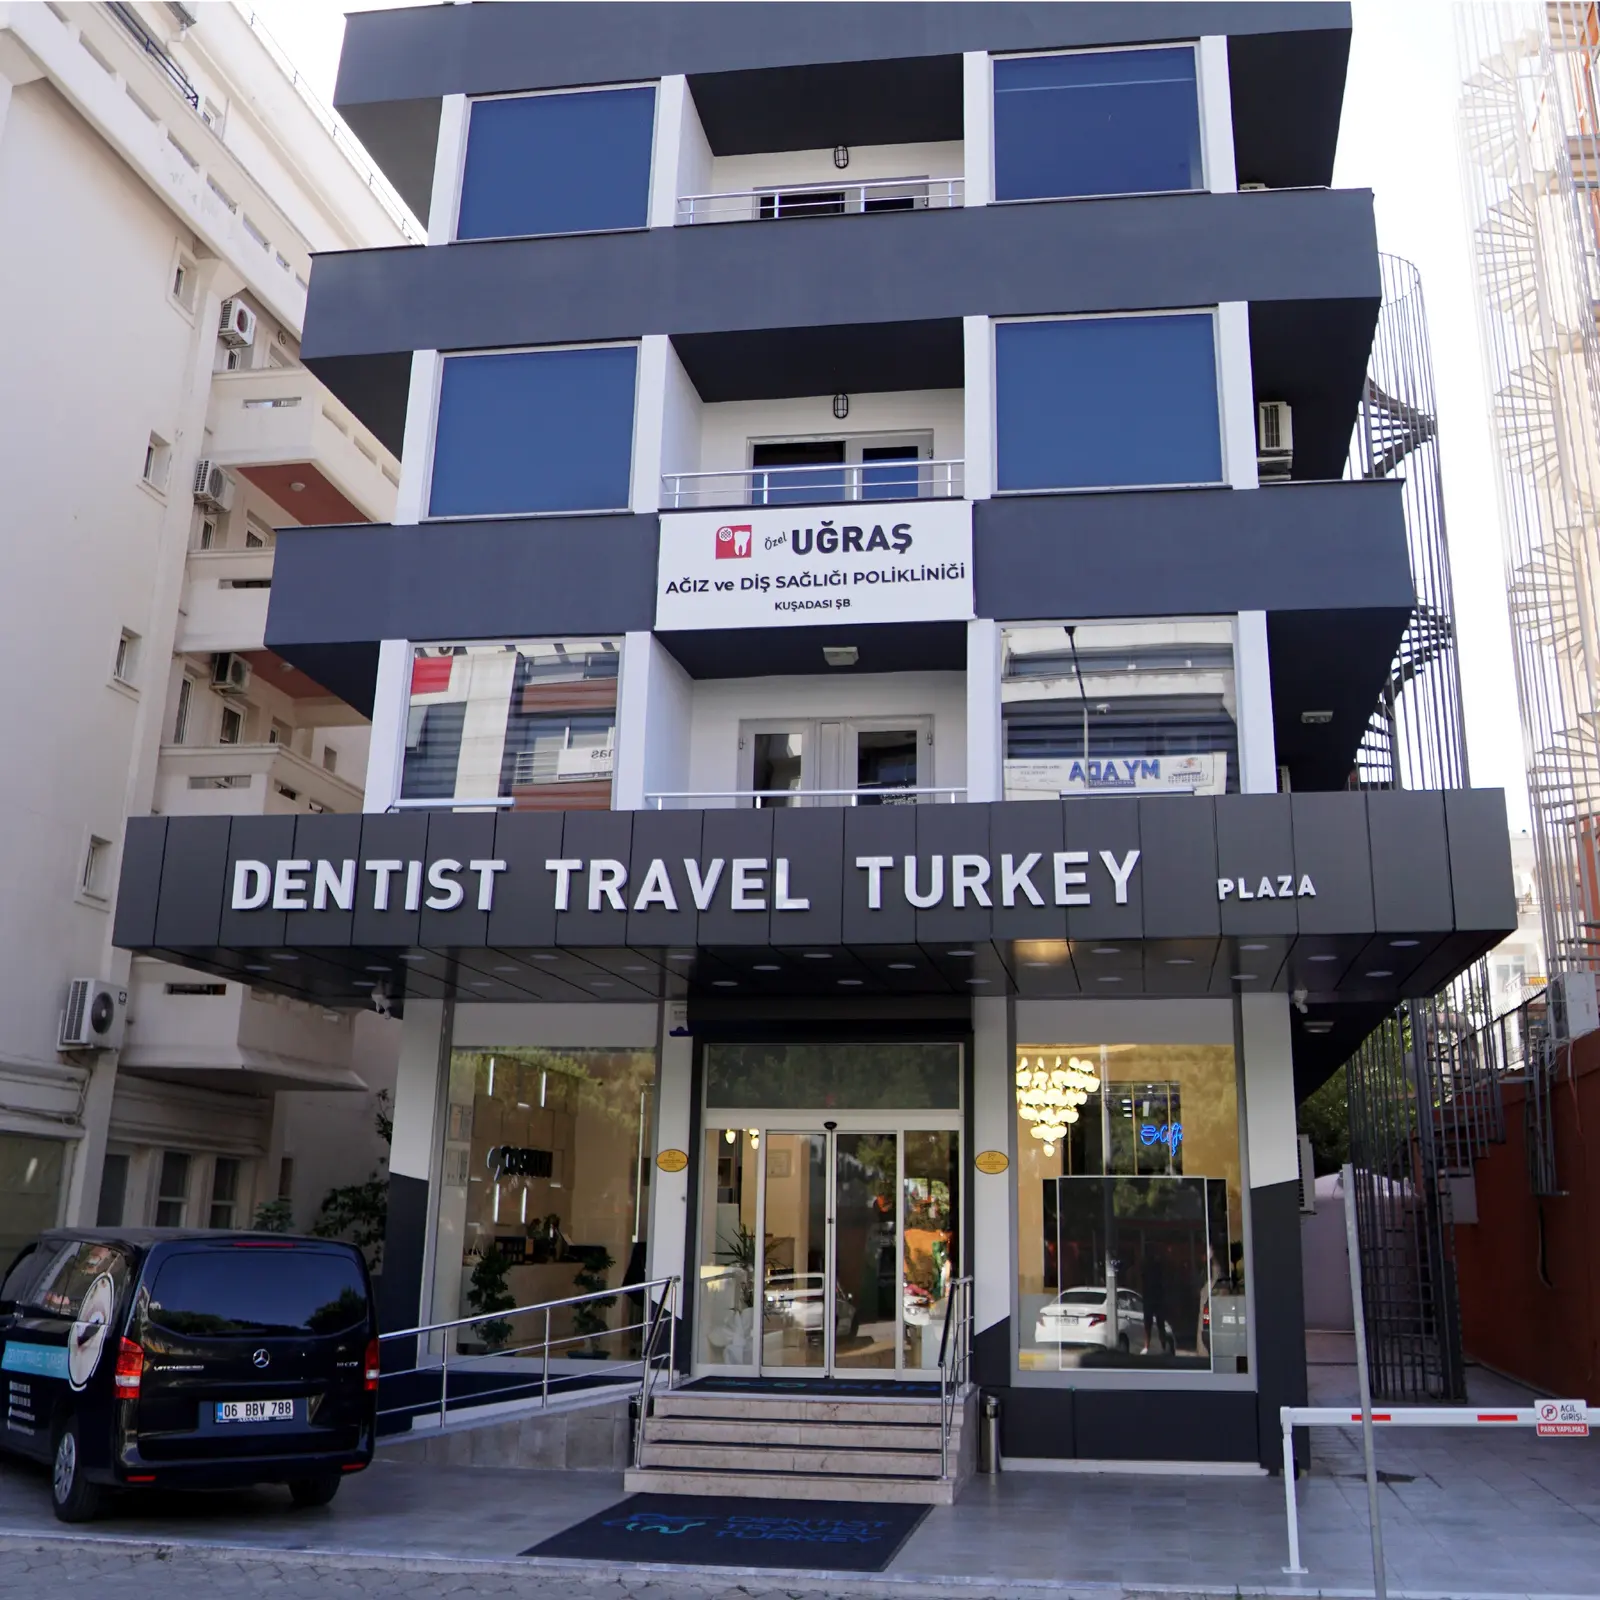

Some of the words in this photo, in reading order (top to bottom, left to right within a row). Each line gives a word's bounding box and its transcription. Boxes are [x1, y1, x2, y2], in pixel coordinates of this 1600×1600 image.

[764, 531, 788, 551] Özel
[791, 520, 913, 556] UĞRAŞ
[666, 577, 710, 595] AĞIZ
[714, 580, 735, 592] ve
[740, 574, 771, 594] DİŞ
[775, 570, 848, 589] SAĞLIĞI
[853, 562, 965, 585] POLİKLİNİĞİ
[774, 600, 833, 612] KUŞADASI
[231, 859, 507, 912] DENTIST
[545, 857, 810, 912] TRAVEL
[856, 850, 1140, 909] TURKEY
[1217, 873, 1317, 901] PLAZA
[224, 1404, 238, 1417] 06
[245, 1402, 265, 1416] BBV
[271, 1401, 291, 1415] 788
[1540, 1425, 1556, 1433] PARK
